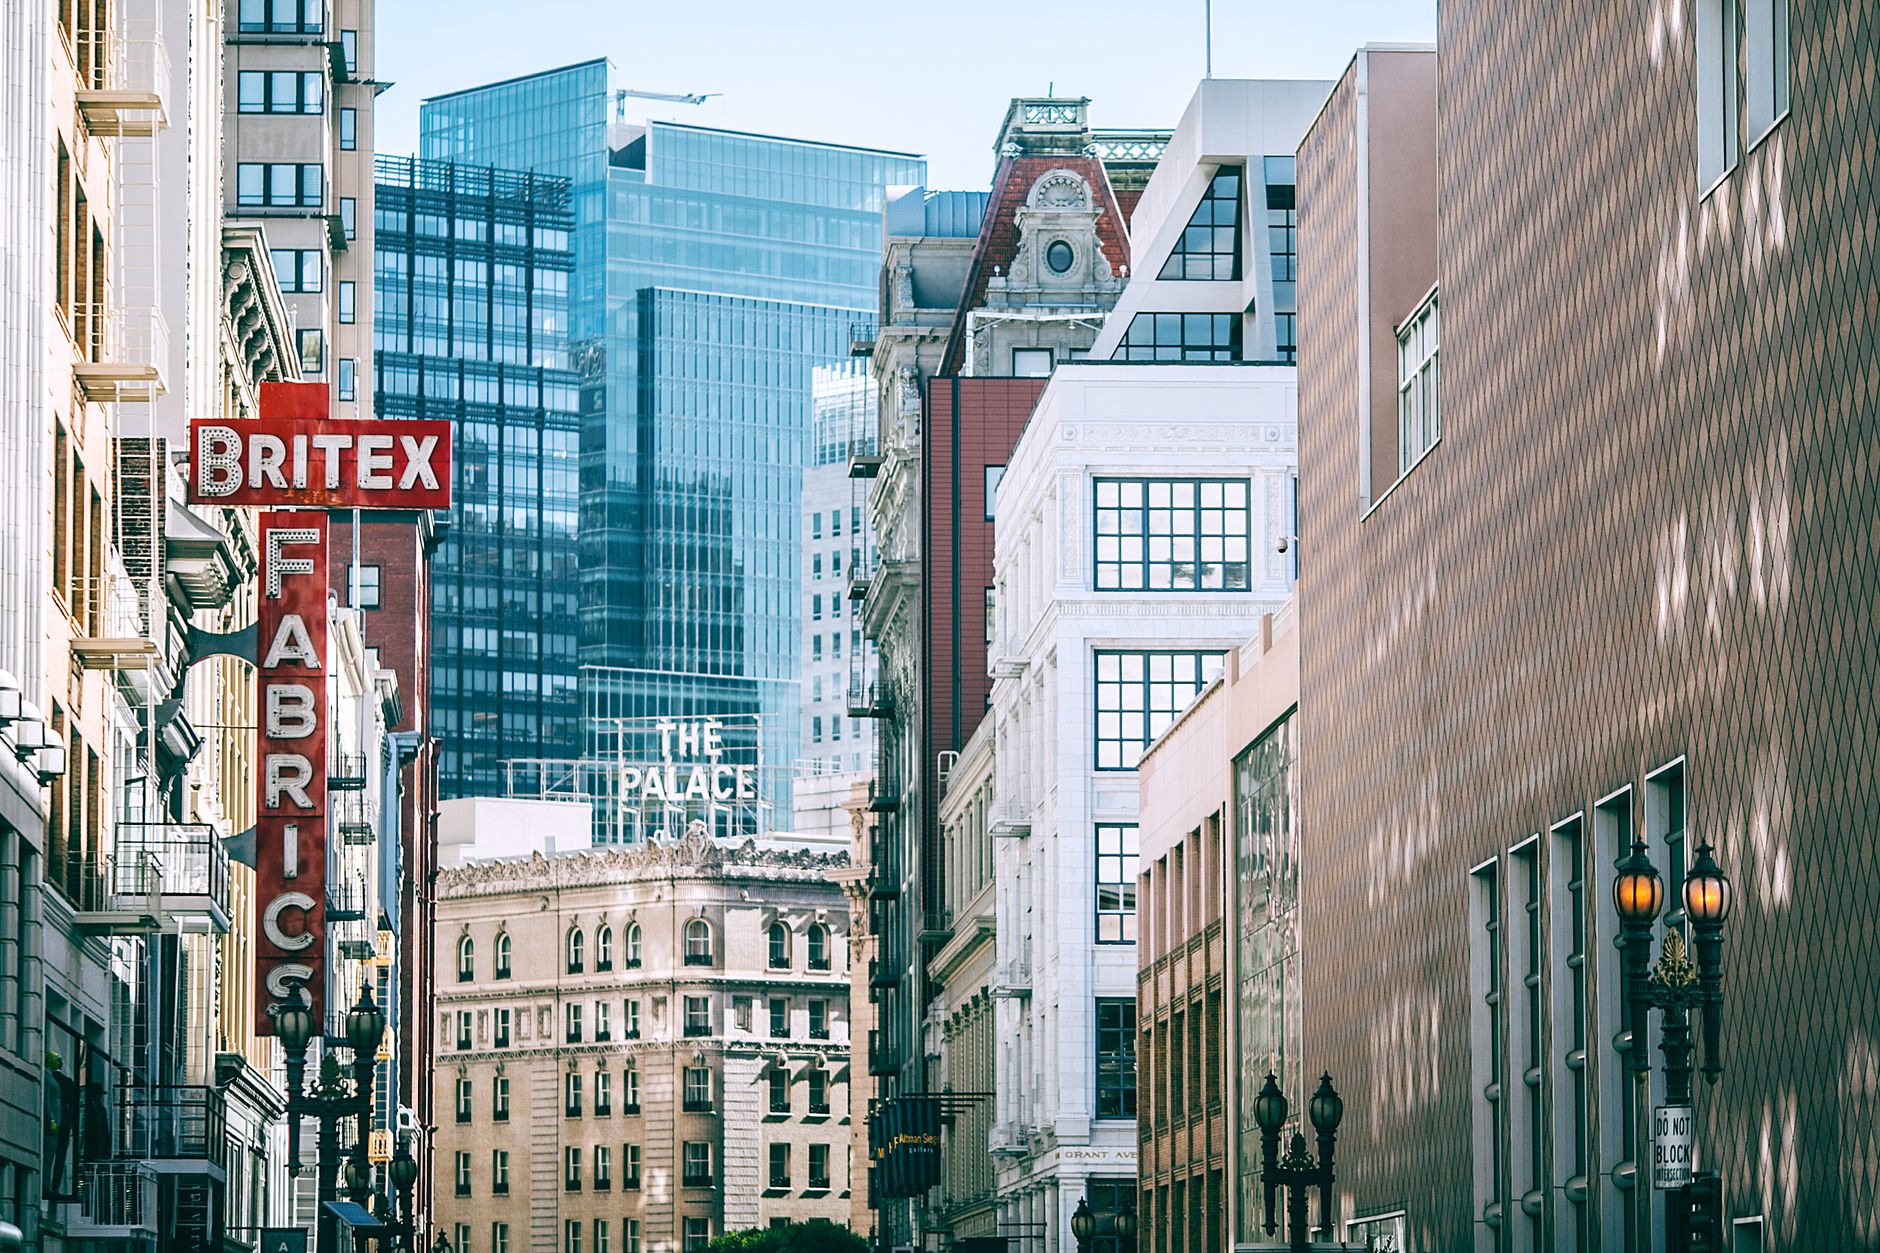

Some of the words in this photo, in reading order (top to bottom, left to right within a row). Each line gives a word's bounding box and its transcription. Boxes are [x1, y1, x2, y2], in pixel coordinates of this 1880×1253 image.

[198, 426, 440, 496] BRITEX
[656, 721, 723, 757] THE
[263, 528, 322, 1017] FABRICS
[621, 764, 756, 801] PALACE
[1657, 1117, 1669, 1136] DO
[1673, 1116, 1690, 1136] NOT
[1065, 1151, 1108, 1159] GRANT
[1656, 1144, 1690, 1164] BLOCK
